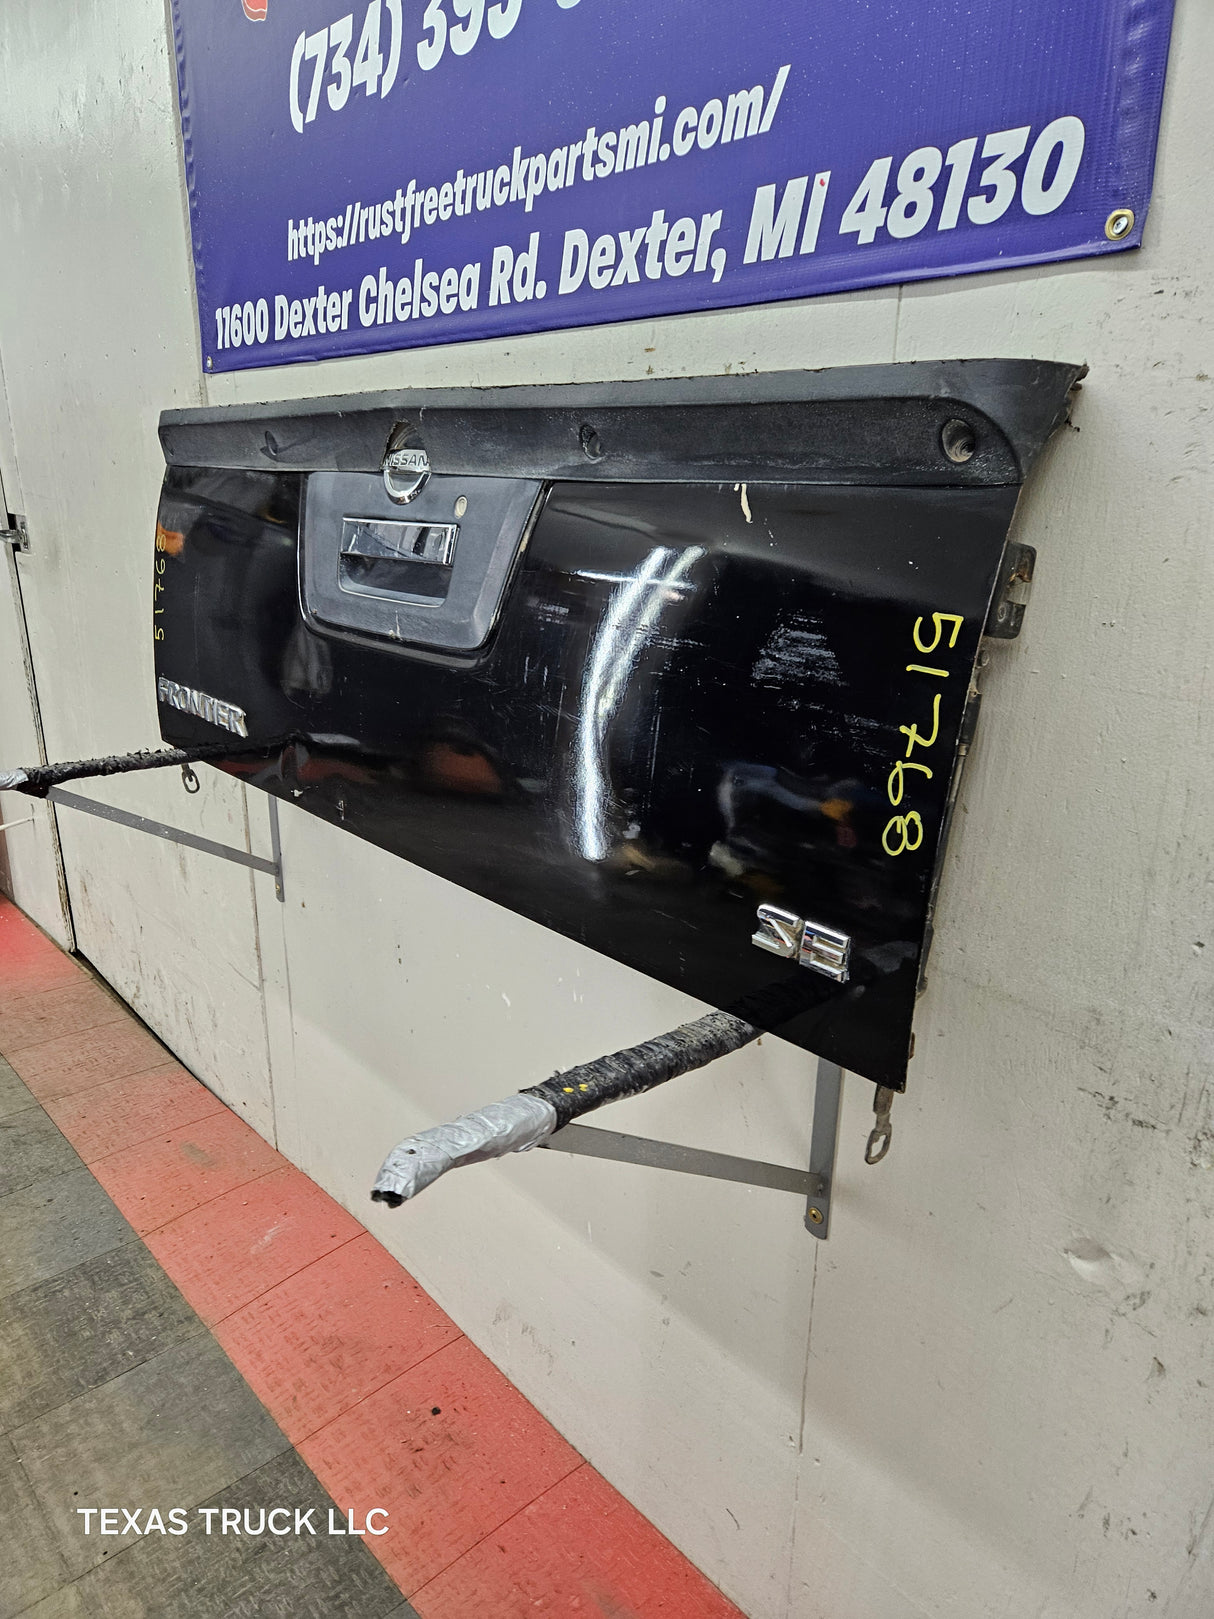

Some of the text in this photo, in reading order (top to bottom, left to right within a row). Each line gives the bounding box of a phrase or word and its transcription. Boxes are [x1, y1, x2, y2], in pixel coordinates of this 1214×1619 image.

[289, 0, 403, 134] (734)
[215, 115, 1085, 350] 11600 Dexter Chelsea Rd. Dexter, MI 48130
[287, 63, 792, 265] https://rustfreetruckpartsmi.com/
[153, 533, 166, 641] 51768
[158, 676, 249, 739] FRONTIER
[881, 611, 965, 856] 51768
